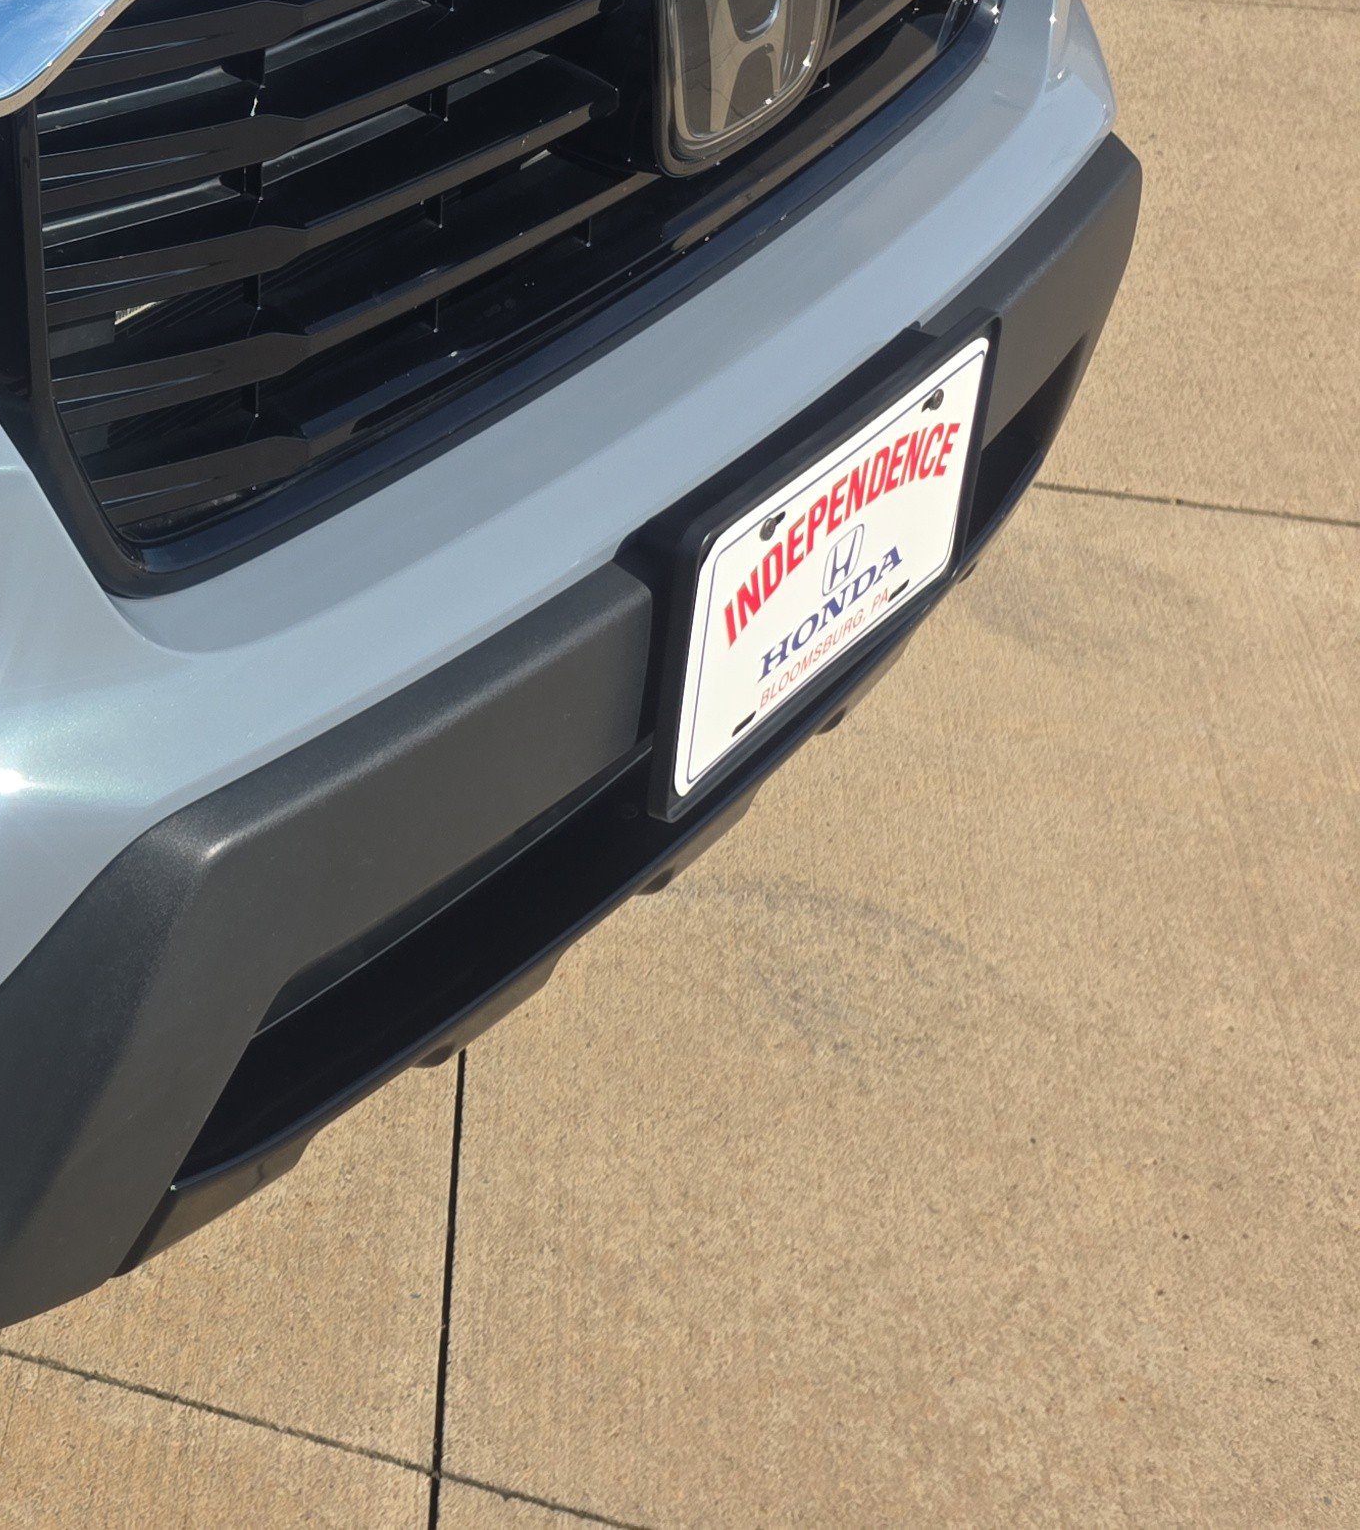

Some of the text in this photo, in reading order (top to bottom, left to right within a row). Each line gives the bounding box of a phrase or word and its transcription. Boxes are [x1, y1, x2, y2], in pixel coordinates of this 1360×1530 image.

[723, 422, 961, 650] INDEPENDENCE
[757, 545, 904, 683] HONDA
[759, 587, 890, 710] BLOOMSBURG, PA
